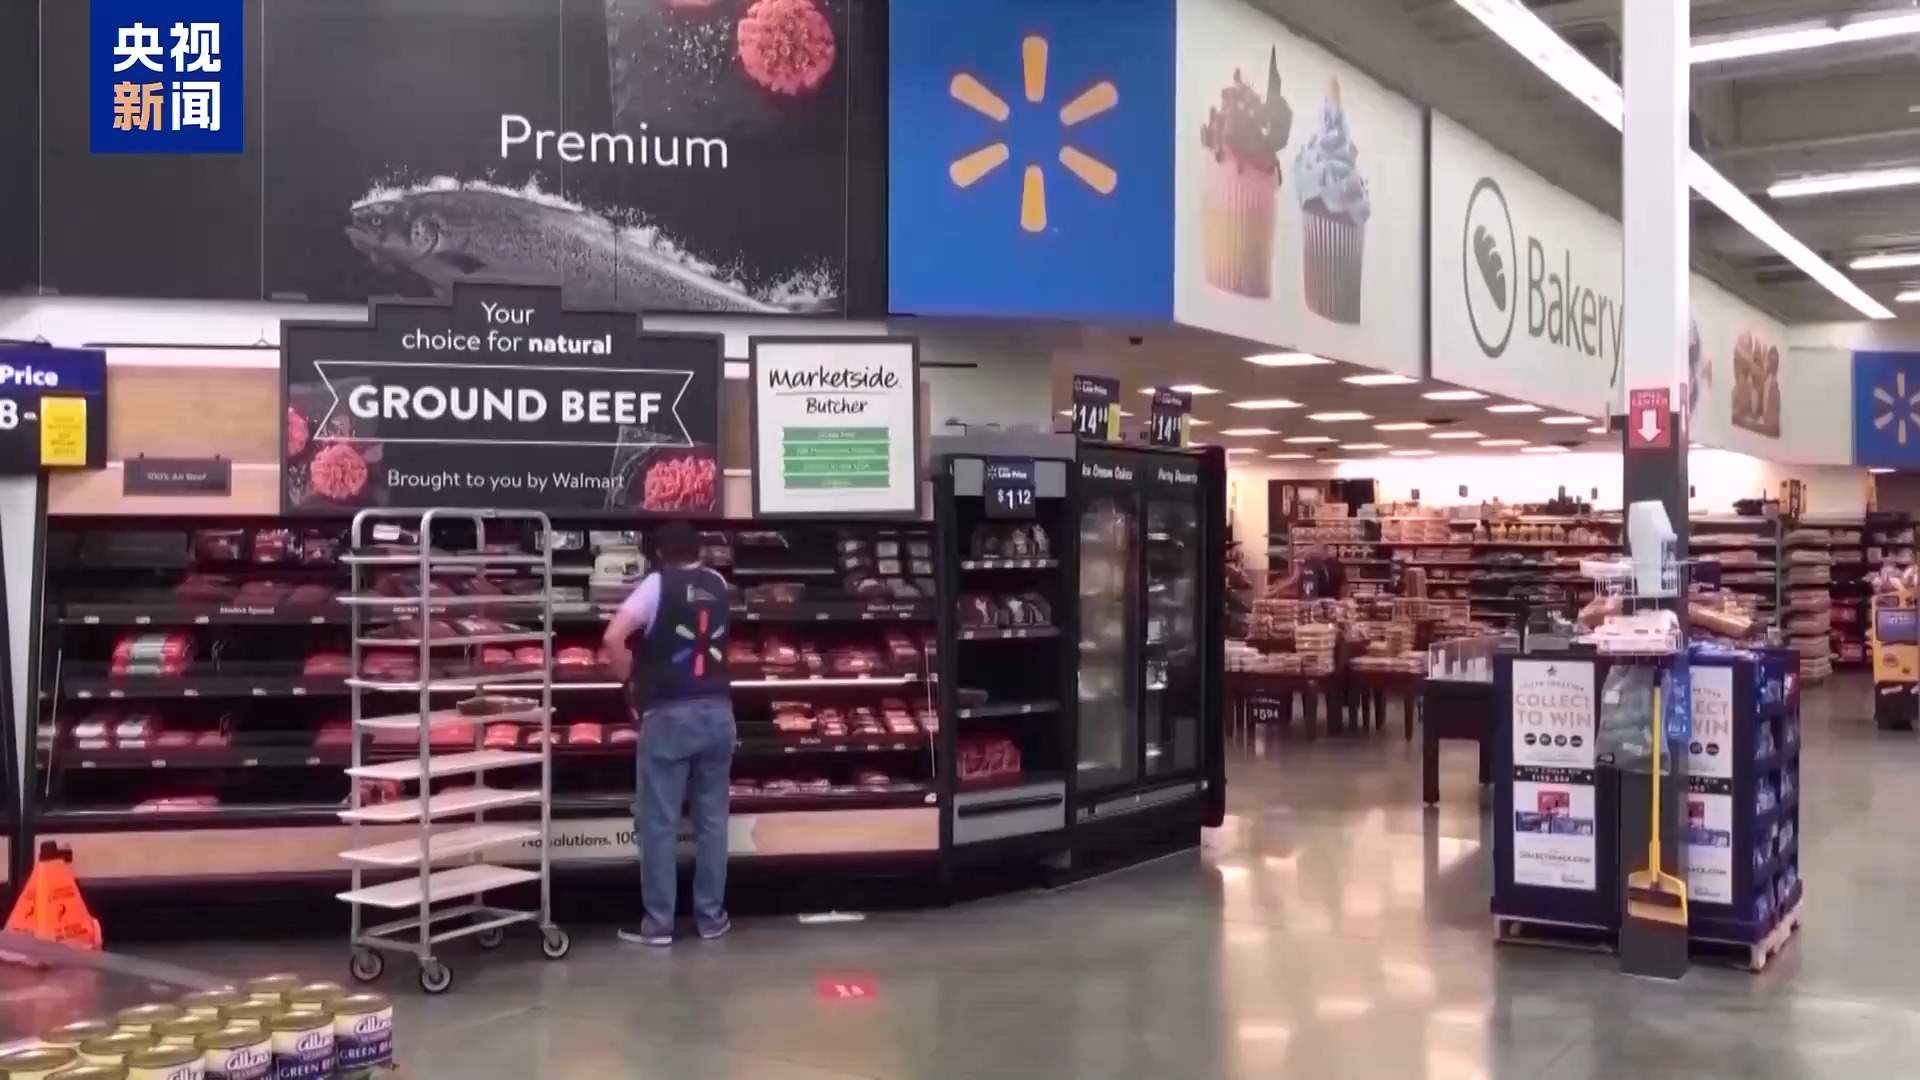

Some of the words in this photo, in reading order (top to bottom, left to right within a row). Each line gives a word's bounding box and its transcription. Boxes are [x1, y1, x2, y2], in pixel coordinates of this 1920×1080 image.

[501, 114, 728, 169] Premium
[481, 301, 535, 326] Your
[1528, 235, 1623, 388] Bakery
[401, 328, 481, 352] choice
[487, 330, 523, 352] for
[528, 333, 612, 355] natural
[0, 364, 58, 387] Price
[769, 364, 899, 389] Marketside
[348, 384, 548, 423] GROUND
[561, 389, 662, 424] BEEF
[806, 397, 868, 414] Butcher
[387, 469, 460, 490] Brought
[466, 472, 485, 487] to
[489, 476, 522, 492] you
[527, 471, 548, 491] by
[552, 472, 626, 490] Walmart
[1516, 693, 1590, 711] COLLECT
[1518, 710, 1543, 726] TO
[1550, 711, 1592, 729] WIN
[550, 832, 611, 848] olutions.
